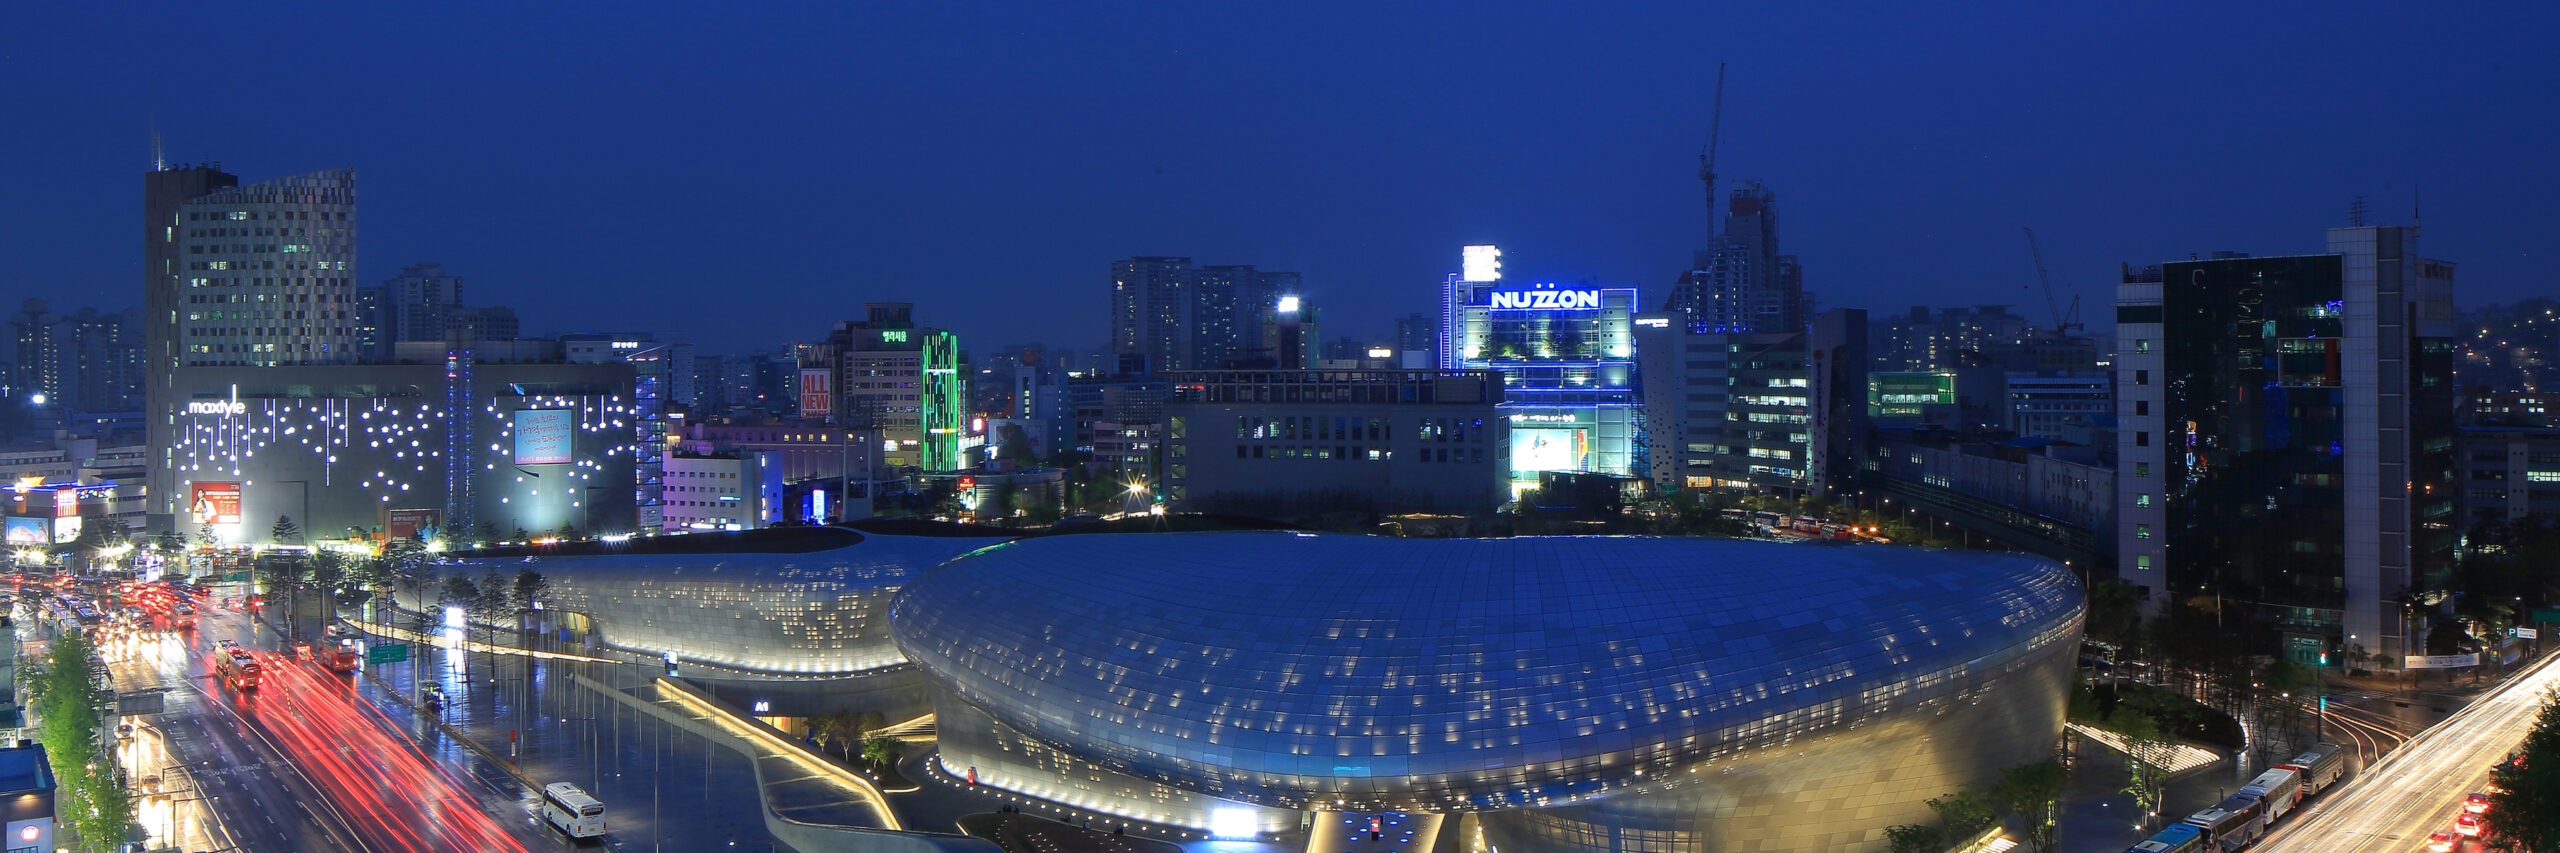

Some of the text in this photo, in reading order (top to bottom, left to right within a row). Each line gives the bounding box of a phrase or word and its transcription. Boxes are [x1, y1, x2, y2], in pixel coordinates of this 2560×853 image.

[1491, 288, 1599, 309] NUZZON
[802, 375, 829, 393] ALL
[188, 383, 246, 420] maxtyle
[802, 394, 829, 409] NEW
[2508, 628, 2516, 636] P
[755, 701, 769, 711] A1
